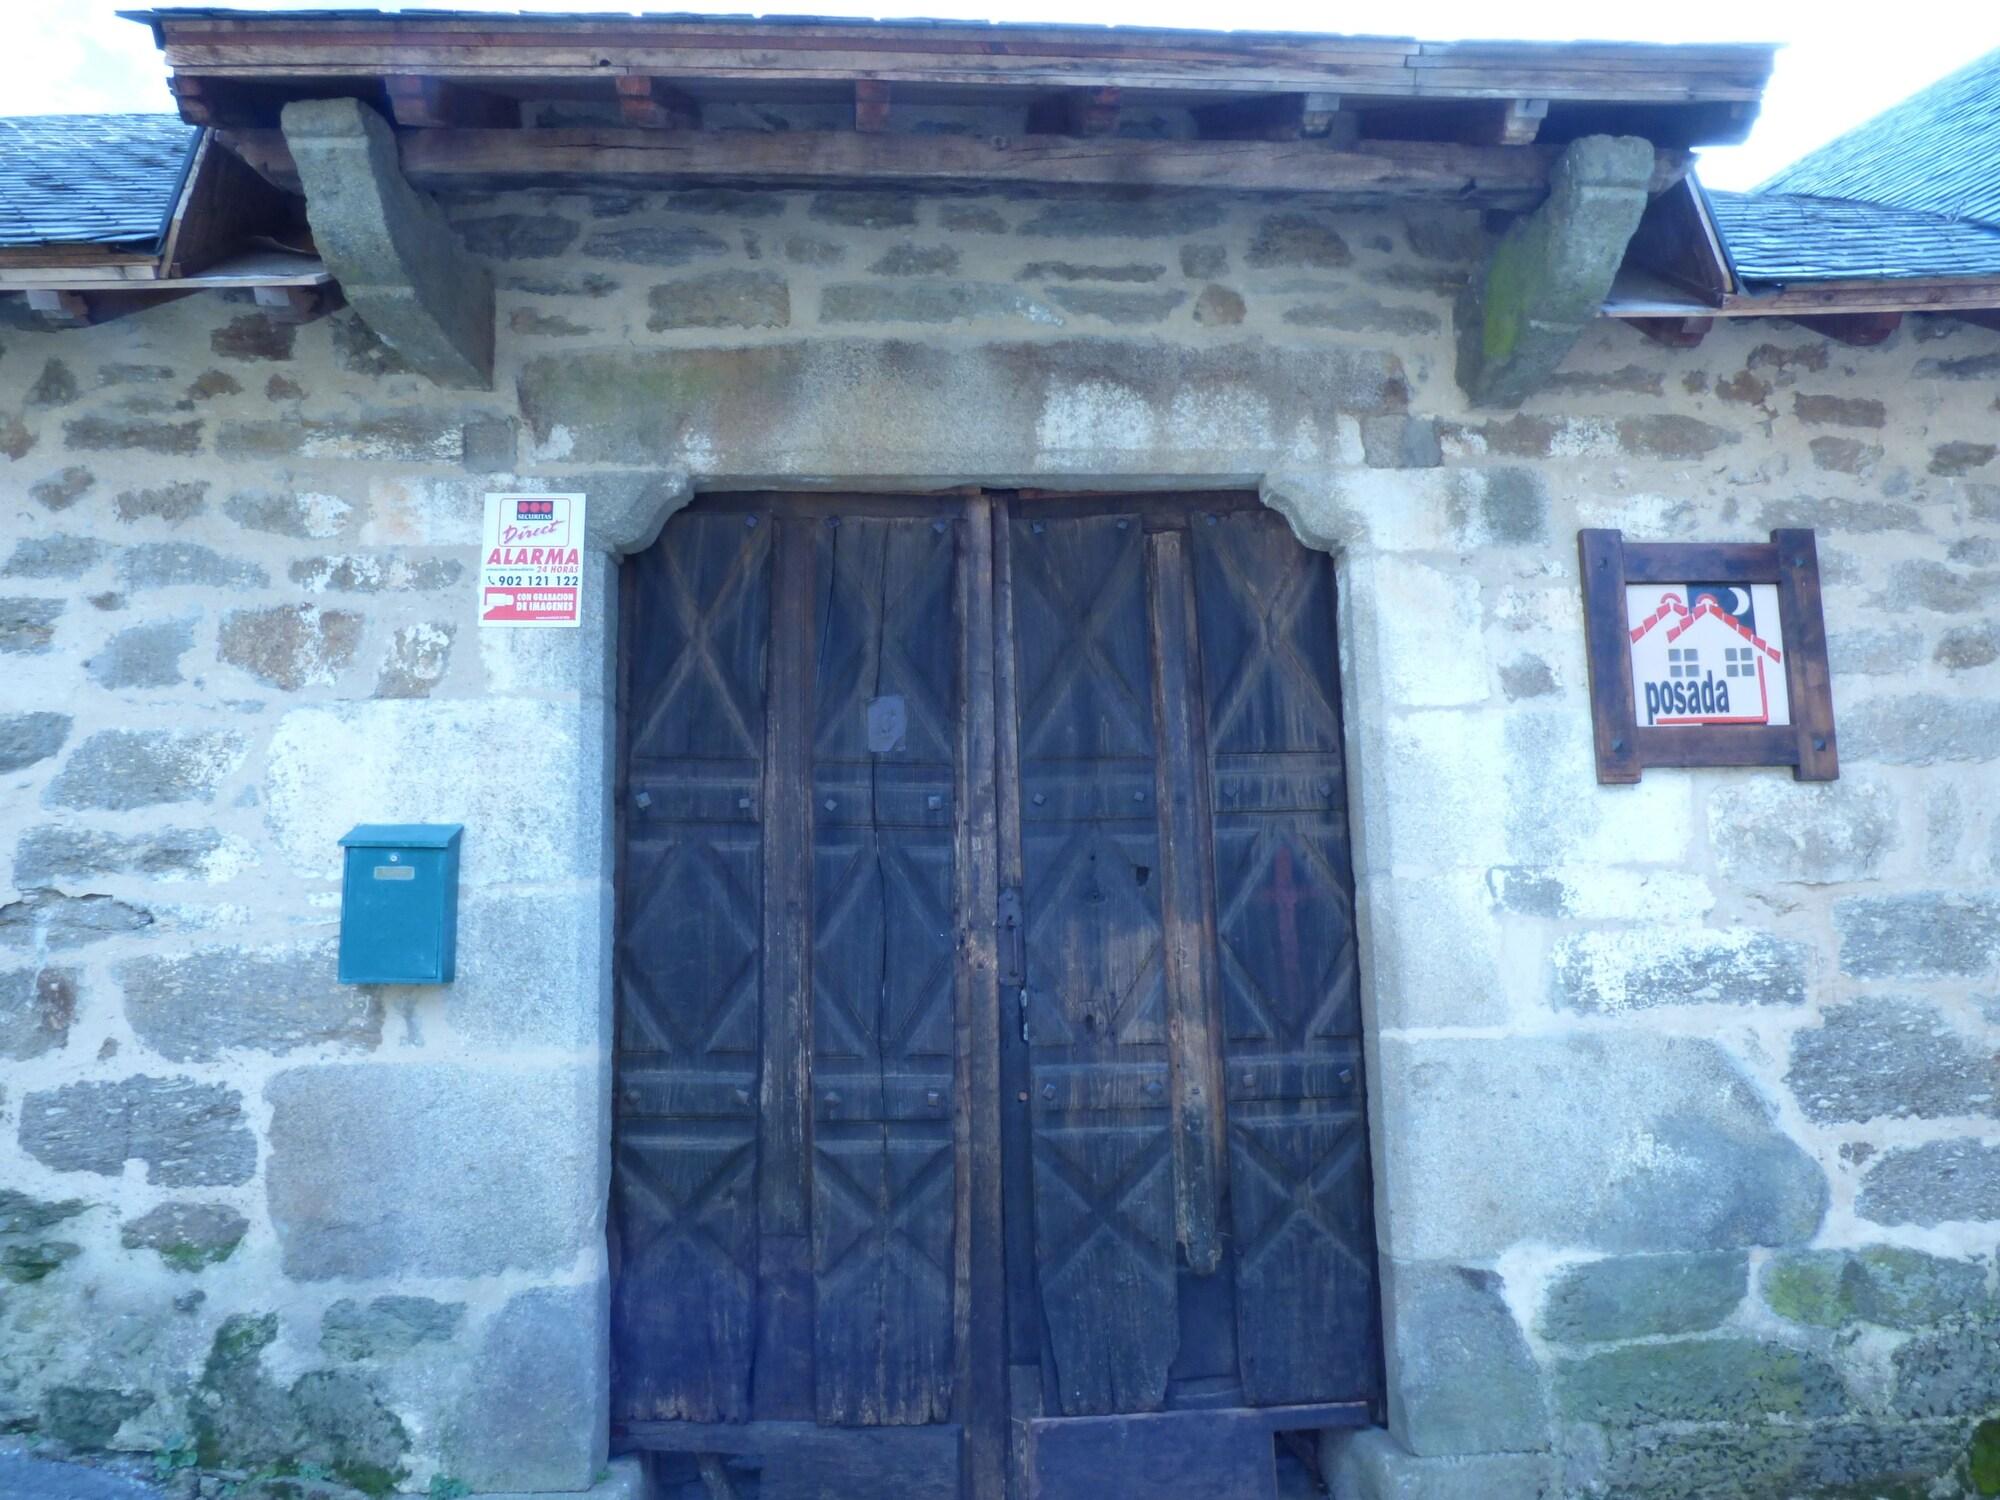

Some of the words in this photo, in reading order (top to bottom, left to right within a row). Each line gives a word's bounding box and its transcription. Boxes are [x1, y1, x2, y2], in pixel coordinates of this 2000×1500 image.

[503, 520, 565, 544] Direct
[487, 548, 579, 565] ALARMA
[499, 576, 522, 586] 902
[528, 576, 549, 586] 121
[557, 576, 579, 586] 122
[517, 593, 531, 601] CON
[532, 593, 573, 601] GRABACION
[516, 602, 527, 611] DE
[529, 602, 573, 611] IMAGENES
[1644, 670, 1730, 725] posada
